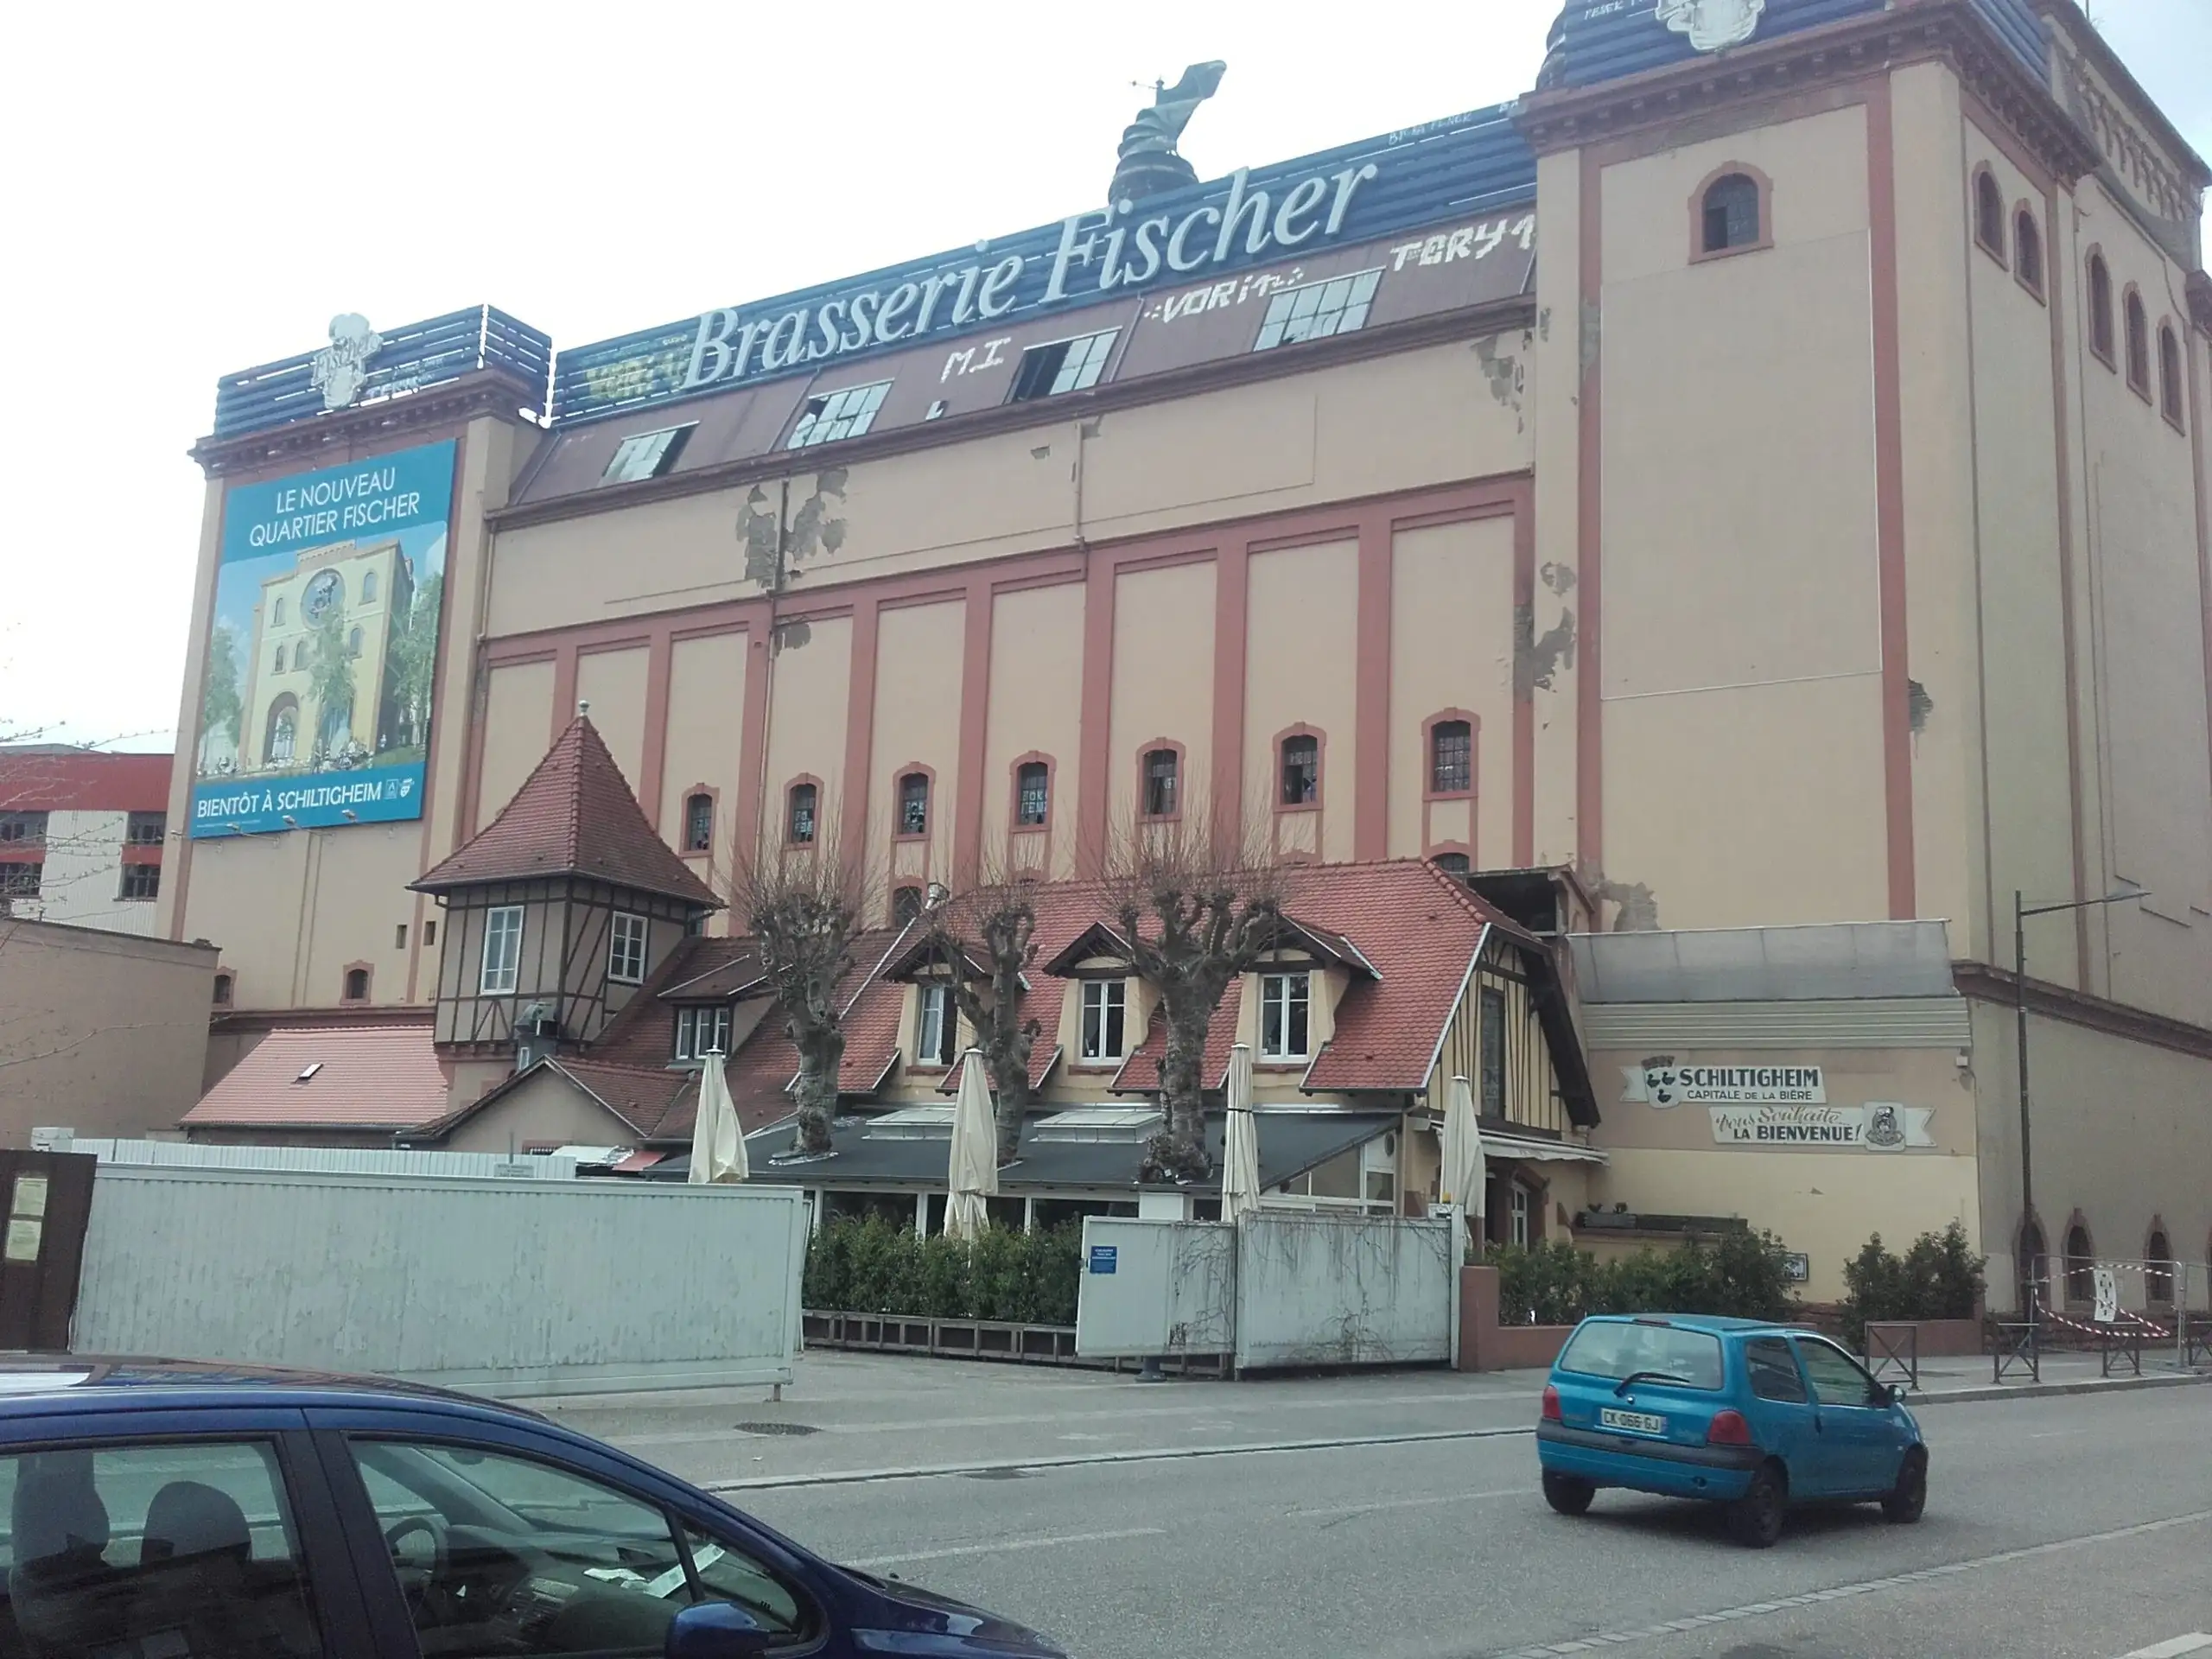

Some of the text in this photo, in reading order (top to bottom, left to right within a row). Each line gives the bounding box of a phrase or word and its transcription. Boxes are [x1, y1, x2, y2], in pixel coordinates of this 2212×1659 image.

[680, 163, 1378, 390] Brasserie Fischer
[276, 467, 396, 514] LE NOUVEAU
[250, 491, 421, 547] QUARTIER FISCHER
[197, 780, 382, 818] BIENTÔT À SCHILTIGHEIM
[1679, 1067, 1819, 1087] SCHILTIGHEIM
[1687, 1090, 1740, 1100] CAPITALE
[1763, 1091, 1776, 1100] LA
[1733, 1128, 1751, 1140] LA
